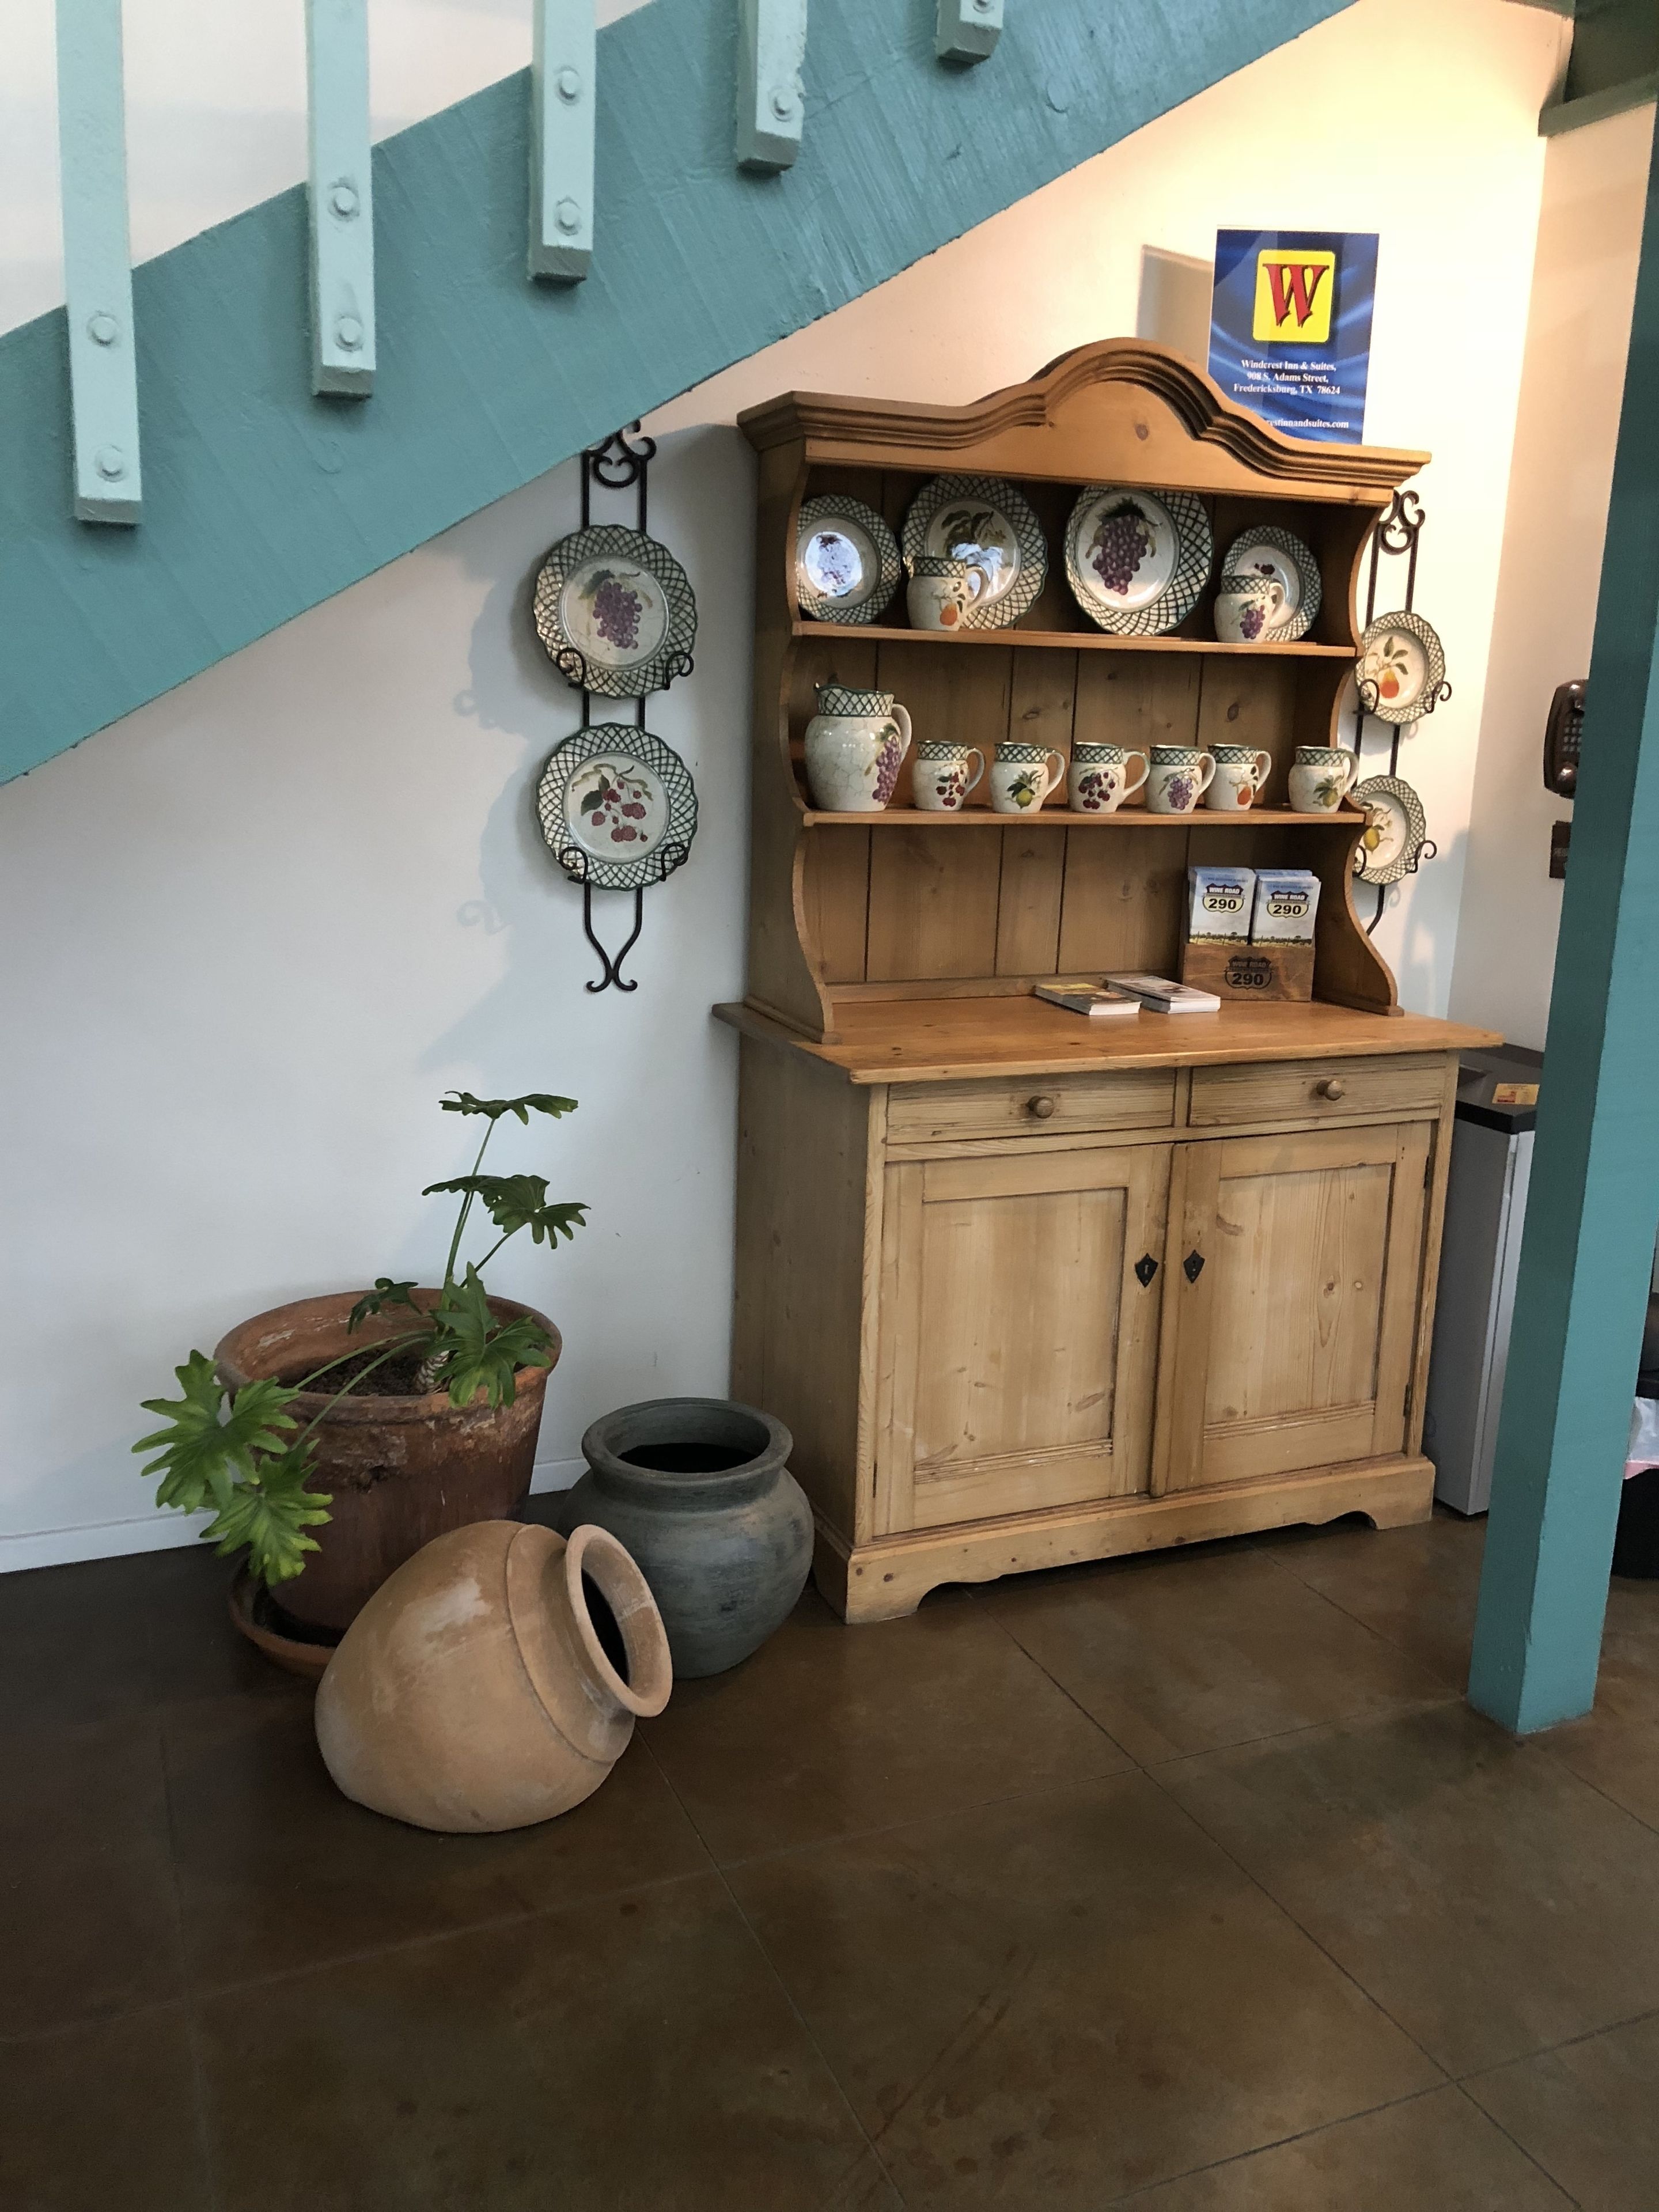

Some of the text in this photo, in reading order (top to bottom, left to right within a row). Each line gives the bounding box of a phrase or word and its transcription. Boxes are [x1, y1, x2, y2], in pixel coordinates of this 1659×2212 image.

[1262, 263, 1330, 328] W
[1241, 359, 1336, 372] Windcrest Inn & Suites,
[1263, 372, 1271, 381] S.
[1273, 373, 1301, 382] Adams
[1302, 373, 1329, 383] Street,
[1234, 383, 1340, 395] Fredericksburg, TX 78624
[1209, 898, 1236, 910] 290
[1272, 904, 1301, 915] 290
[1232, 972, 1264, 986] 290
